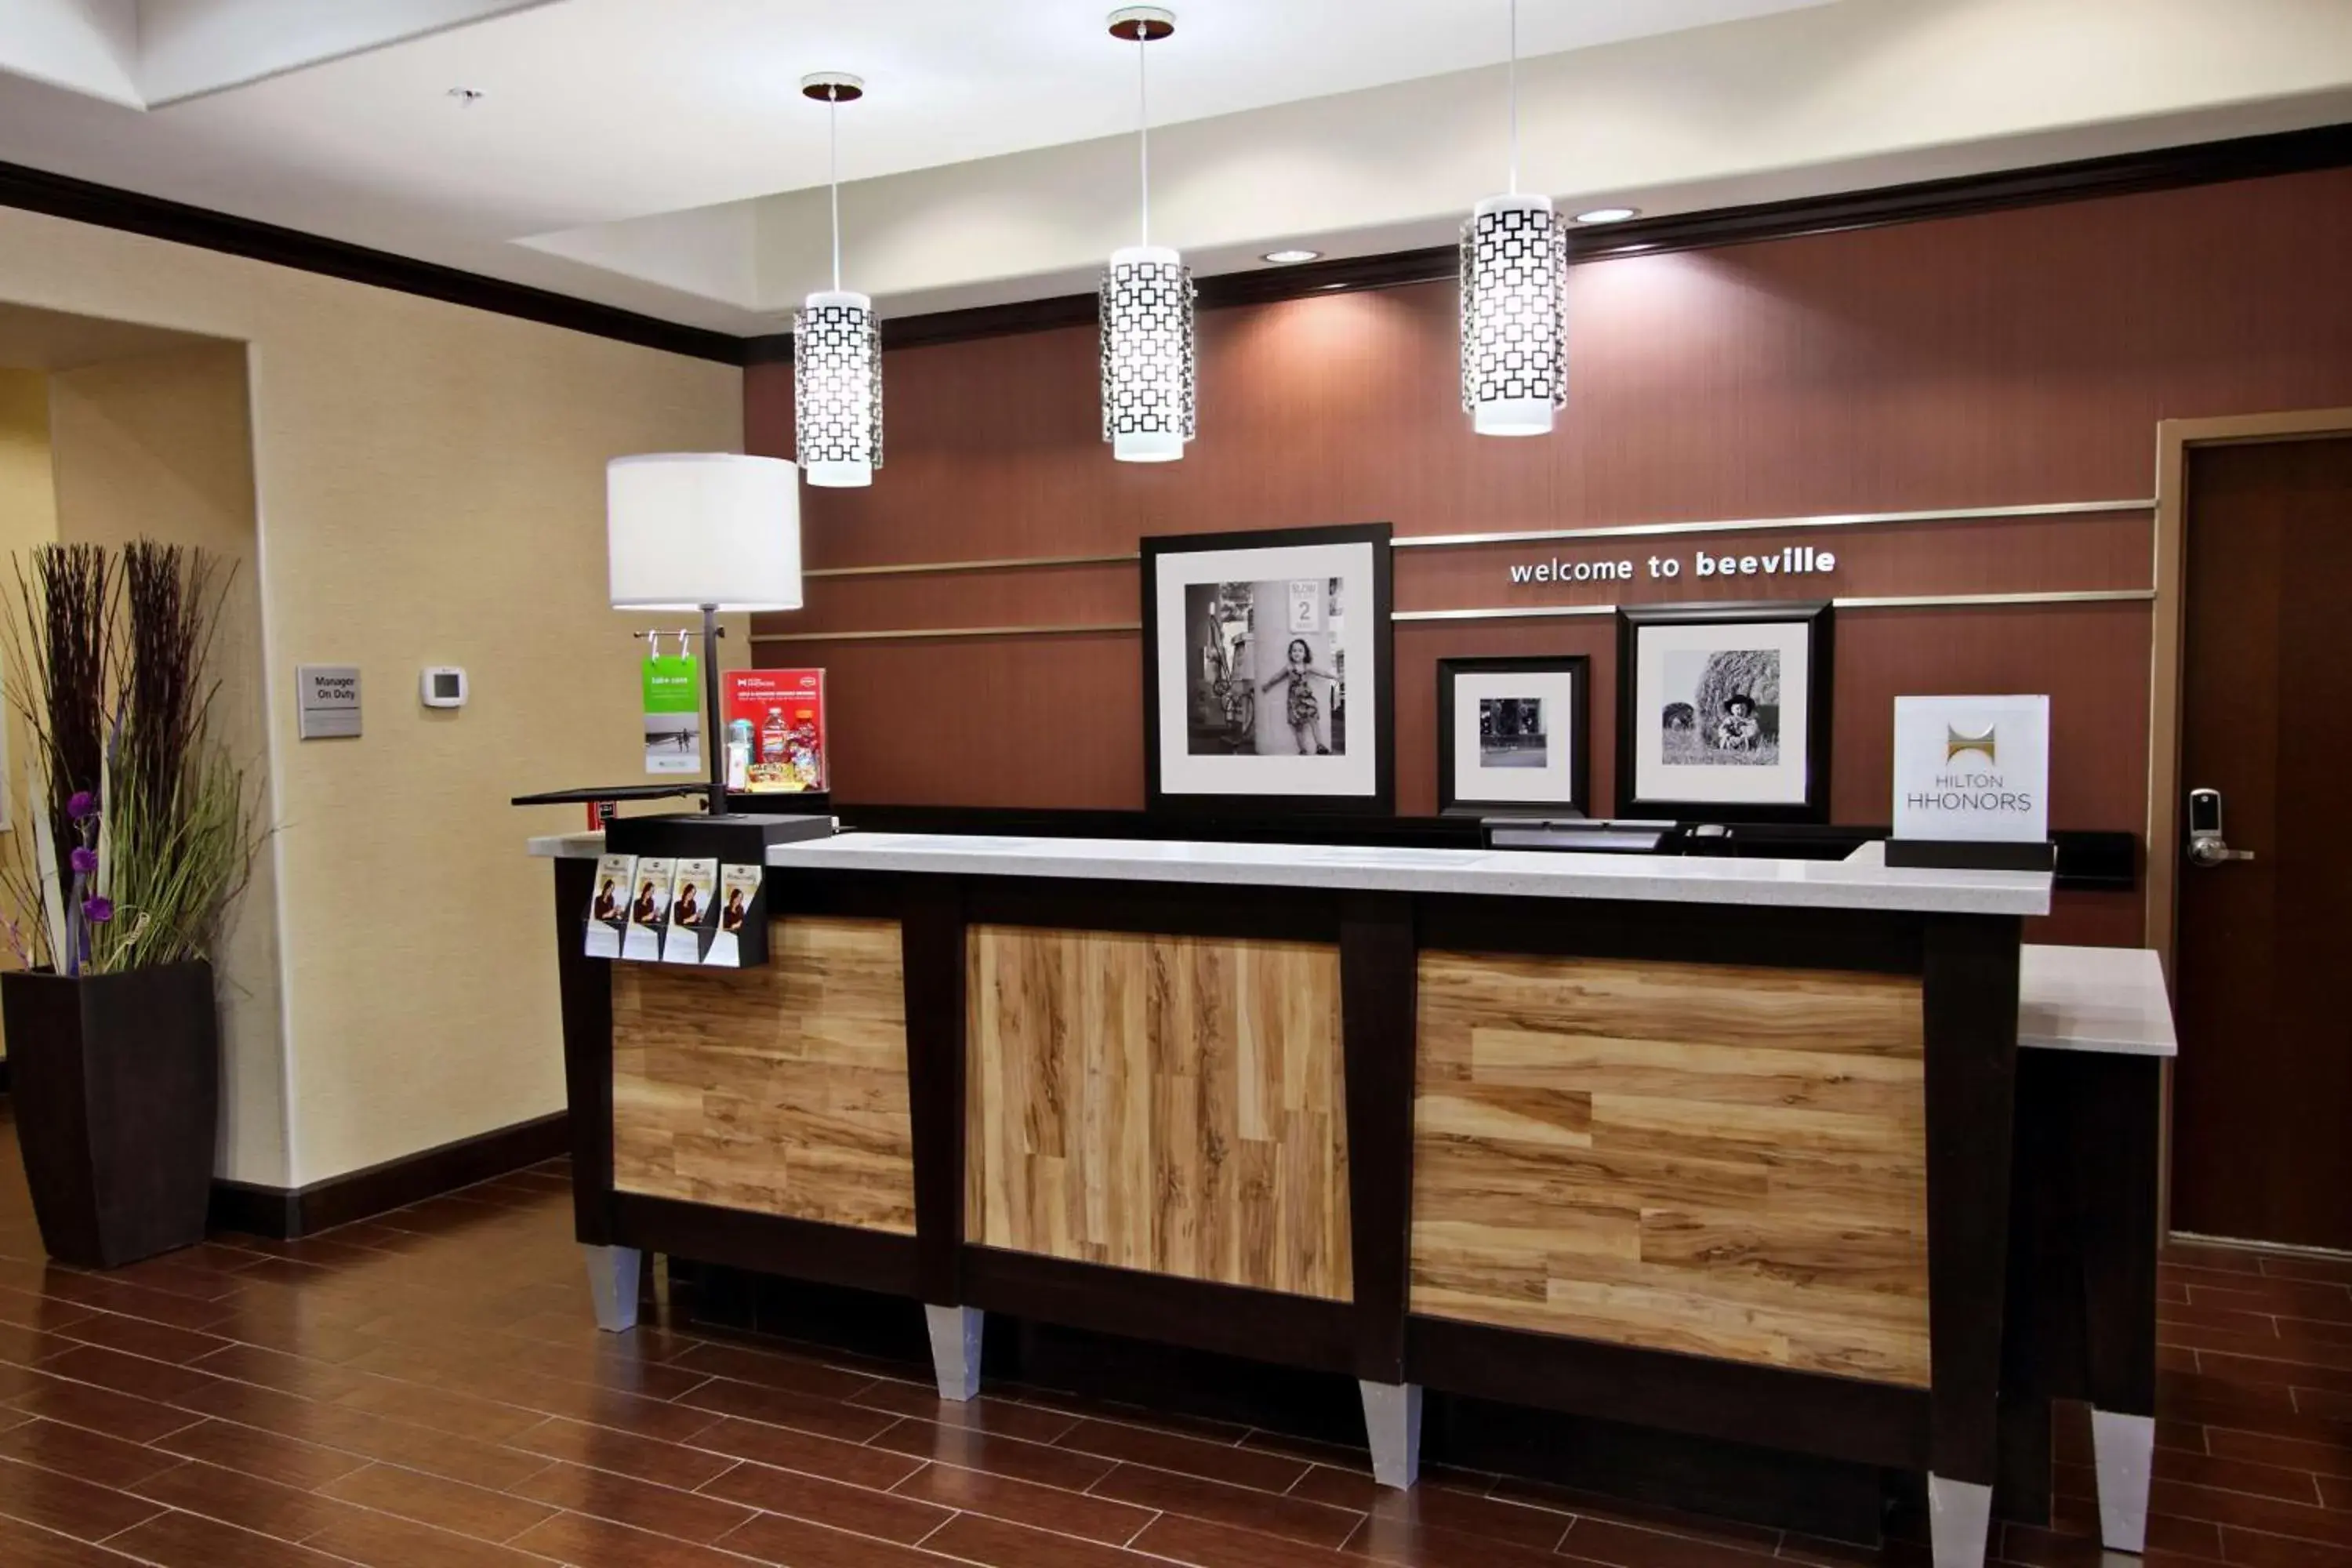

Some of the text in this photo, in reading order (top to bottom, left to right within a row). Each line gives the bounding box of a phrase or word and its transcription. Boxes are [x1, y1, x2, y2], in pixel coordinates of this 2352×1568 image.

[1509, 546, 1835, 583] welcome to beeville
[1298, 601, 1311, 620] 2
[315, 677, 354, 688] Manager
[318, 689, 355, 700] On Duty
[1936, 774, 2004, 789] HILTON
[1907, 793, 2032, 811] HHONORS
